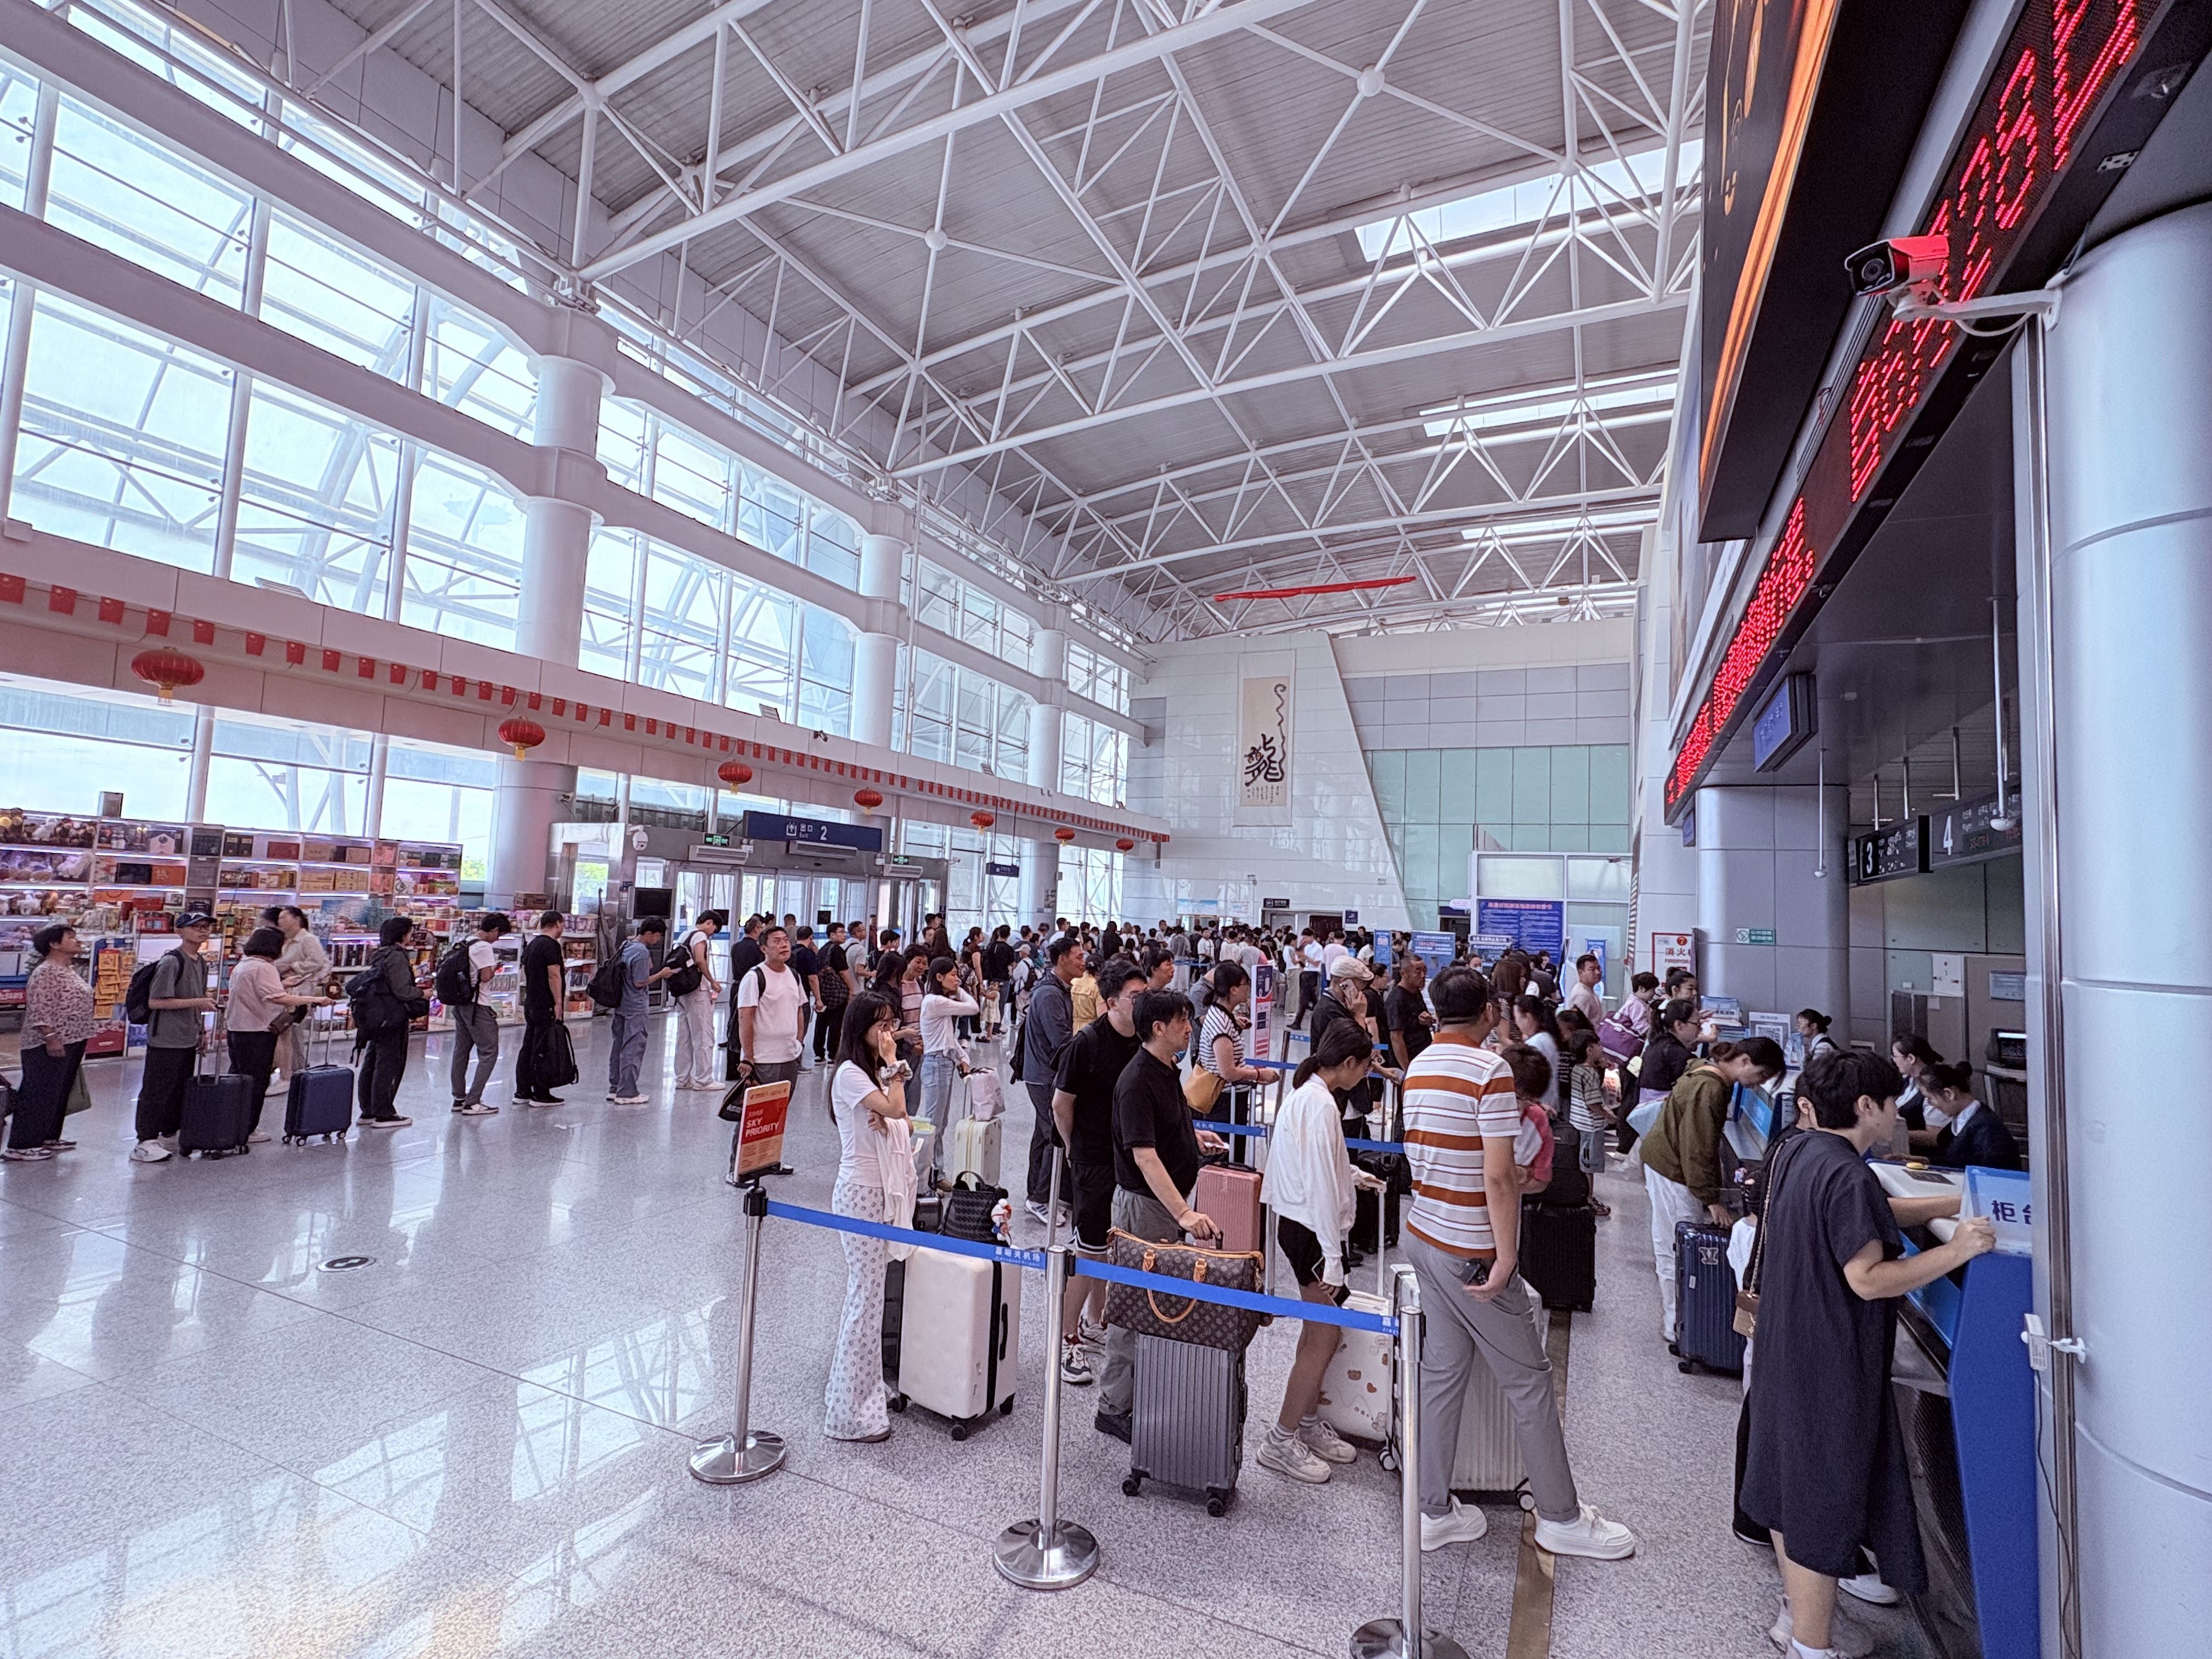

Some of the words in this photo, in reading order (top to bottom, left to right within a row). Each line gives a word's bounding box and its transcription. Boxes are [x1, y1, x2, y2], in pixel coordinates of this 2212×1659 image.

[800, 823, 813, 832] 出口
[820, 825, 827, 840] 2
[1943, 815, 1953, 856] 4
[1866, 841, 1873, 874] 3
[745, 1121, 780, 1137] PRIORITY
[746, 1117, 763, 1128] SKY
[996, 1246, 1040, 1262] 嘉峪关机场
